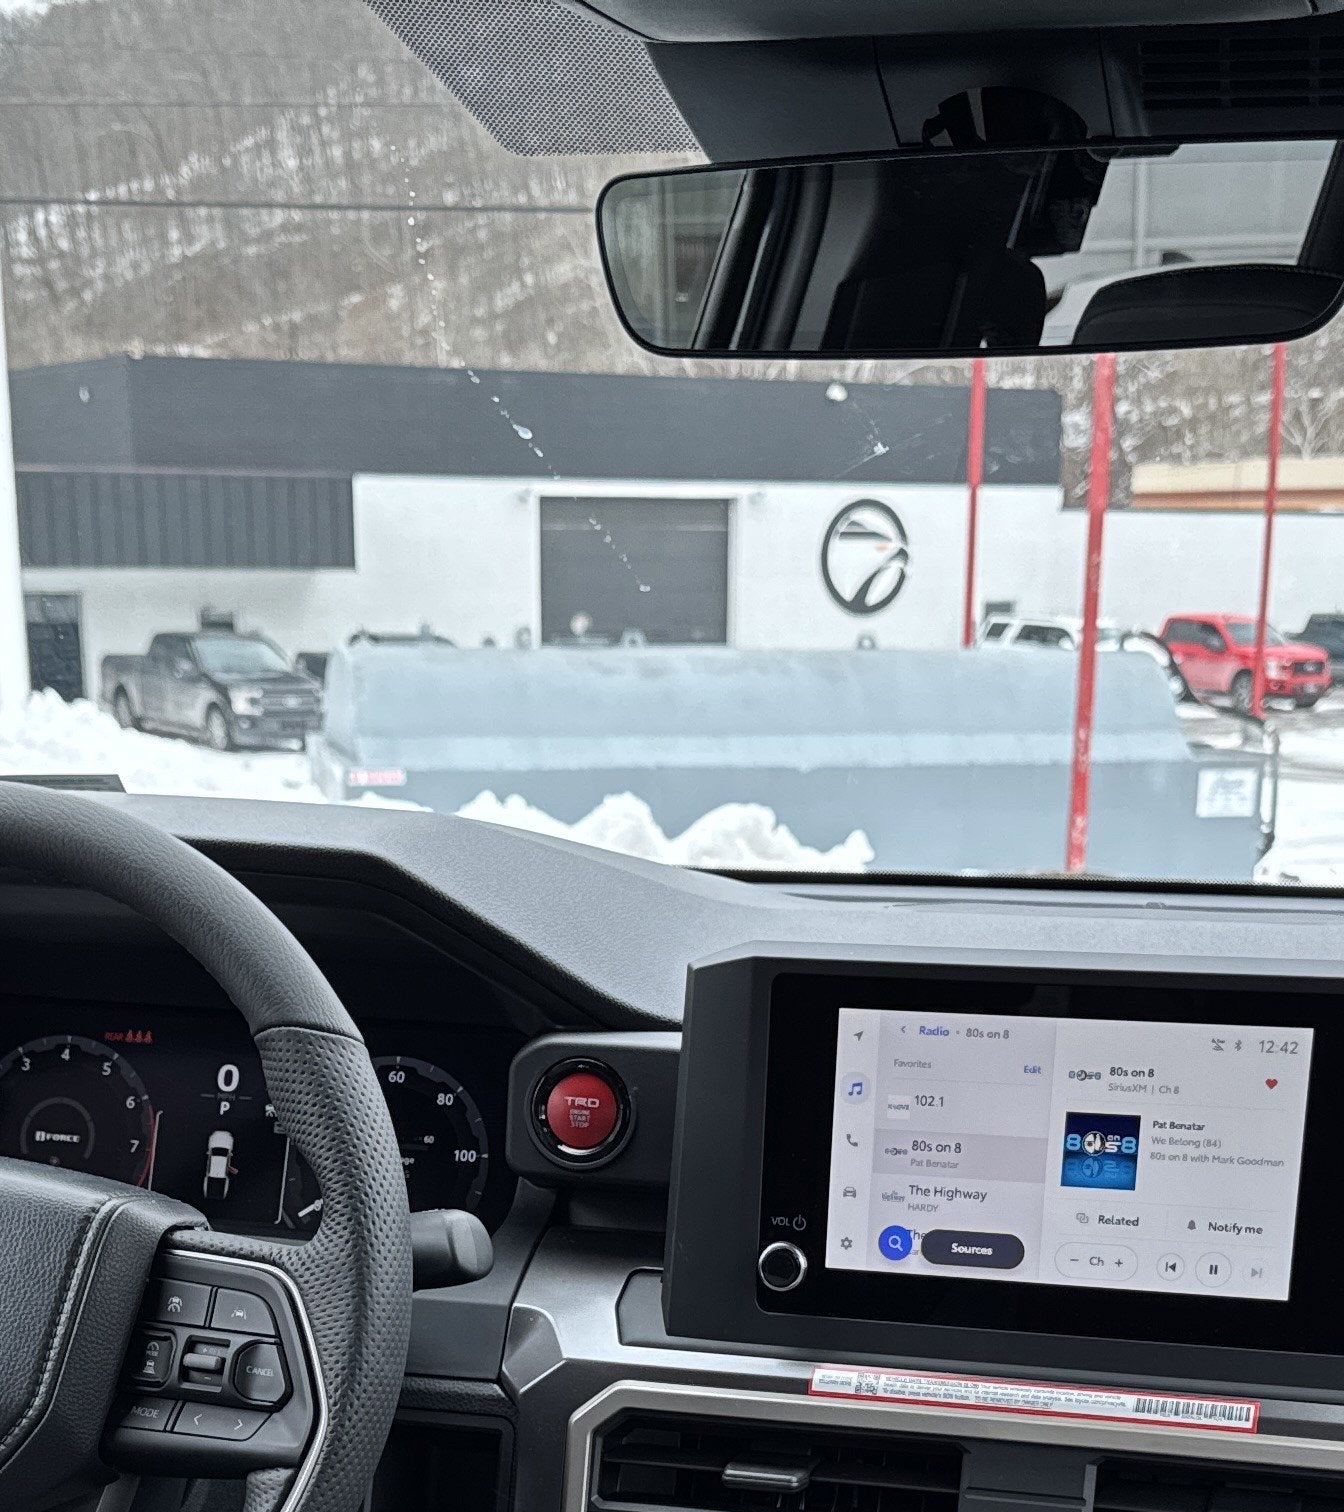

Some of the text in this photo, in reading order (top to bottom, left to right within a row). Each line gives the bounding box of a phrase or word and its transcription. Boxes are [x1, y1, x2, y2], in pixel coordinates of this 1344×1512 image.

[919, 1026, 1010, 1039] Radio 80s on 8
[60, 1048, 71, 1061] 4
[21, 1057, 31, 1071] 3
[101, 1061, 112, 1076] 5
[893, 1058, 932, 1069] Favorites
[1023, 1065, 1042, 1074] Edit
[217, 1064, 240, 1092] 0
[388, 1071, 405, 1083] 60
[1109, 1066, 1155, 1078] 80s on 8
[1108, 1083, 1180, 1094] SiriusXM Ch 8
[125, 1096, 135, 1109] 6
[437, 1093, 454, 1105] 80
[564, 1096, 599, 1108] TRD
[914, 1094, 945, 1108] 102.1
[220, 1101, 230, 1115] P
[1152, 1121, 1206, 1131] Pat Benatar
[423, 1135, 435, 1144] 60
[1151, 1136, 1222, 1149] We Belong (84)
[129, 1139, 140, 1153] 7
[911, 1140, 933, 1152] 80s
[935, 1143, 952, 1153] on
[954, 1142, 962, 1154] 8
[454, 1150, 476, 1162] 100
[1150, 1152, 1166, 1161] 80s
[1168, 1154, 1181, 1162] on
[1190, 1154, 1210, 1163] with
[1211, 1154, 1235, 1165] Mark
[1237, 1156, 1284, 1167] Goodman
[910, 1158, 959, 1169] Pat Benatar
[909, 1185, 988, 1203] The Highway
[907, 1203, 939, 1213] HARDY
[770, 1216, 790, 1226] VOL
[1098, 1214, 1140, 1227] Related
[1208, 1221, 1264, 1235] Notify me
[951, 1242, 994, 1256] Sources
[1089, 1256, 1104, 1267] Ch
[246, 1365, 274, 1377] CANCEL
[130, 1406, 160, 1418] MODE
